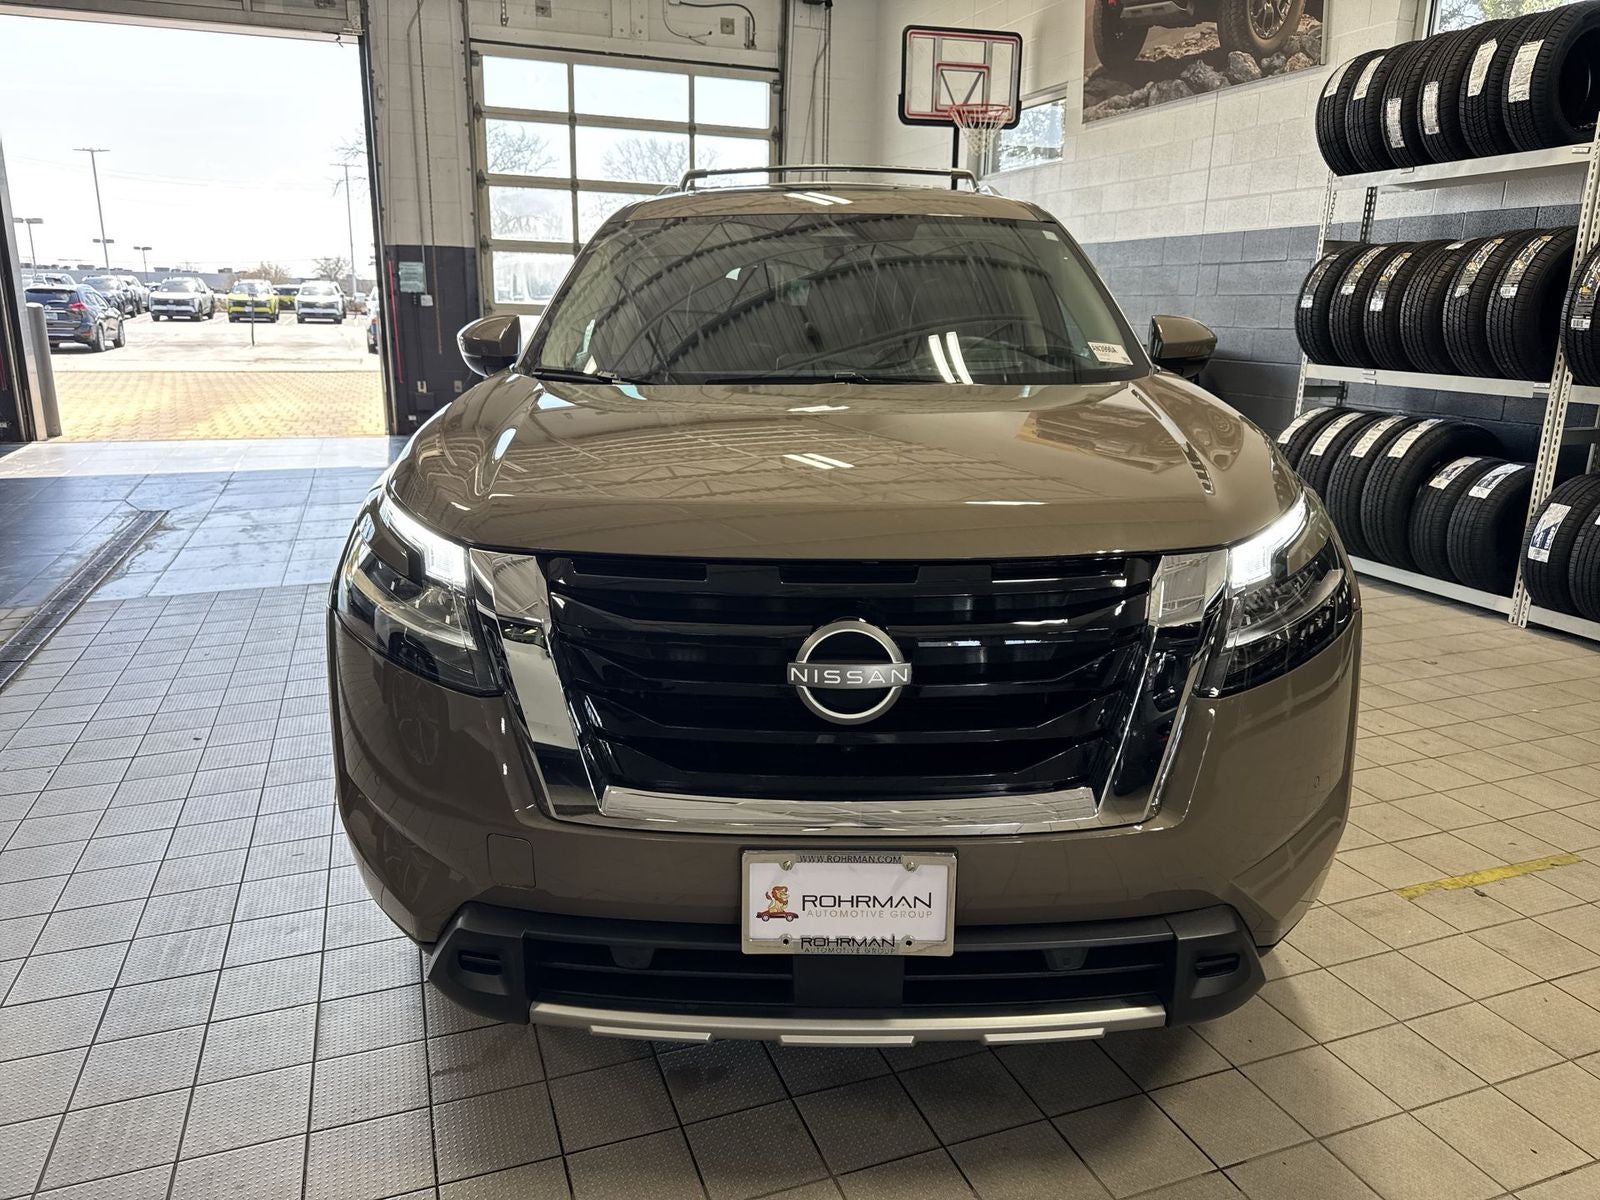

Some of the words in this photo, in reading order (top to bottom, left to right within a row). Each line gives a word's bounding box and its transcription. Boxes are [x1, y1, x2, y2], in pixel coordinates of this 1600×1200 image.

[791, 667, 908, 684] NISSAN
[799, 855, 902, 864] WWW.ROHRMAN.COM
[802, 892, 932, 911] ROHRMAN
[807, 909, 884, 918] AUTOMOTIVE
[890, 910, 932, 919] GROUP
[801, 935, 895, 949] ROHRMAN
